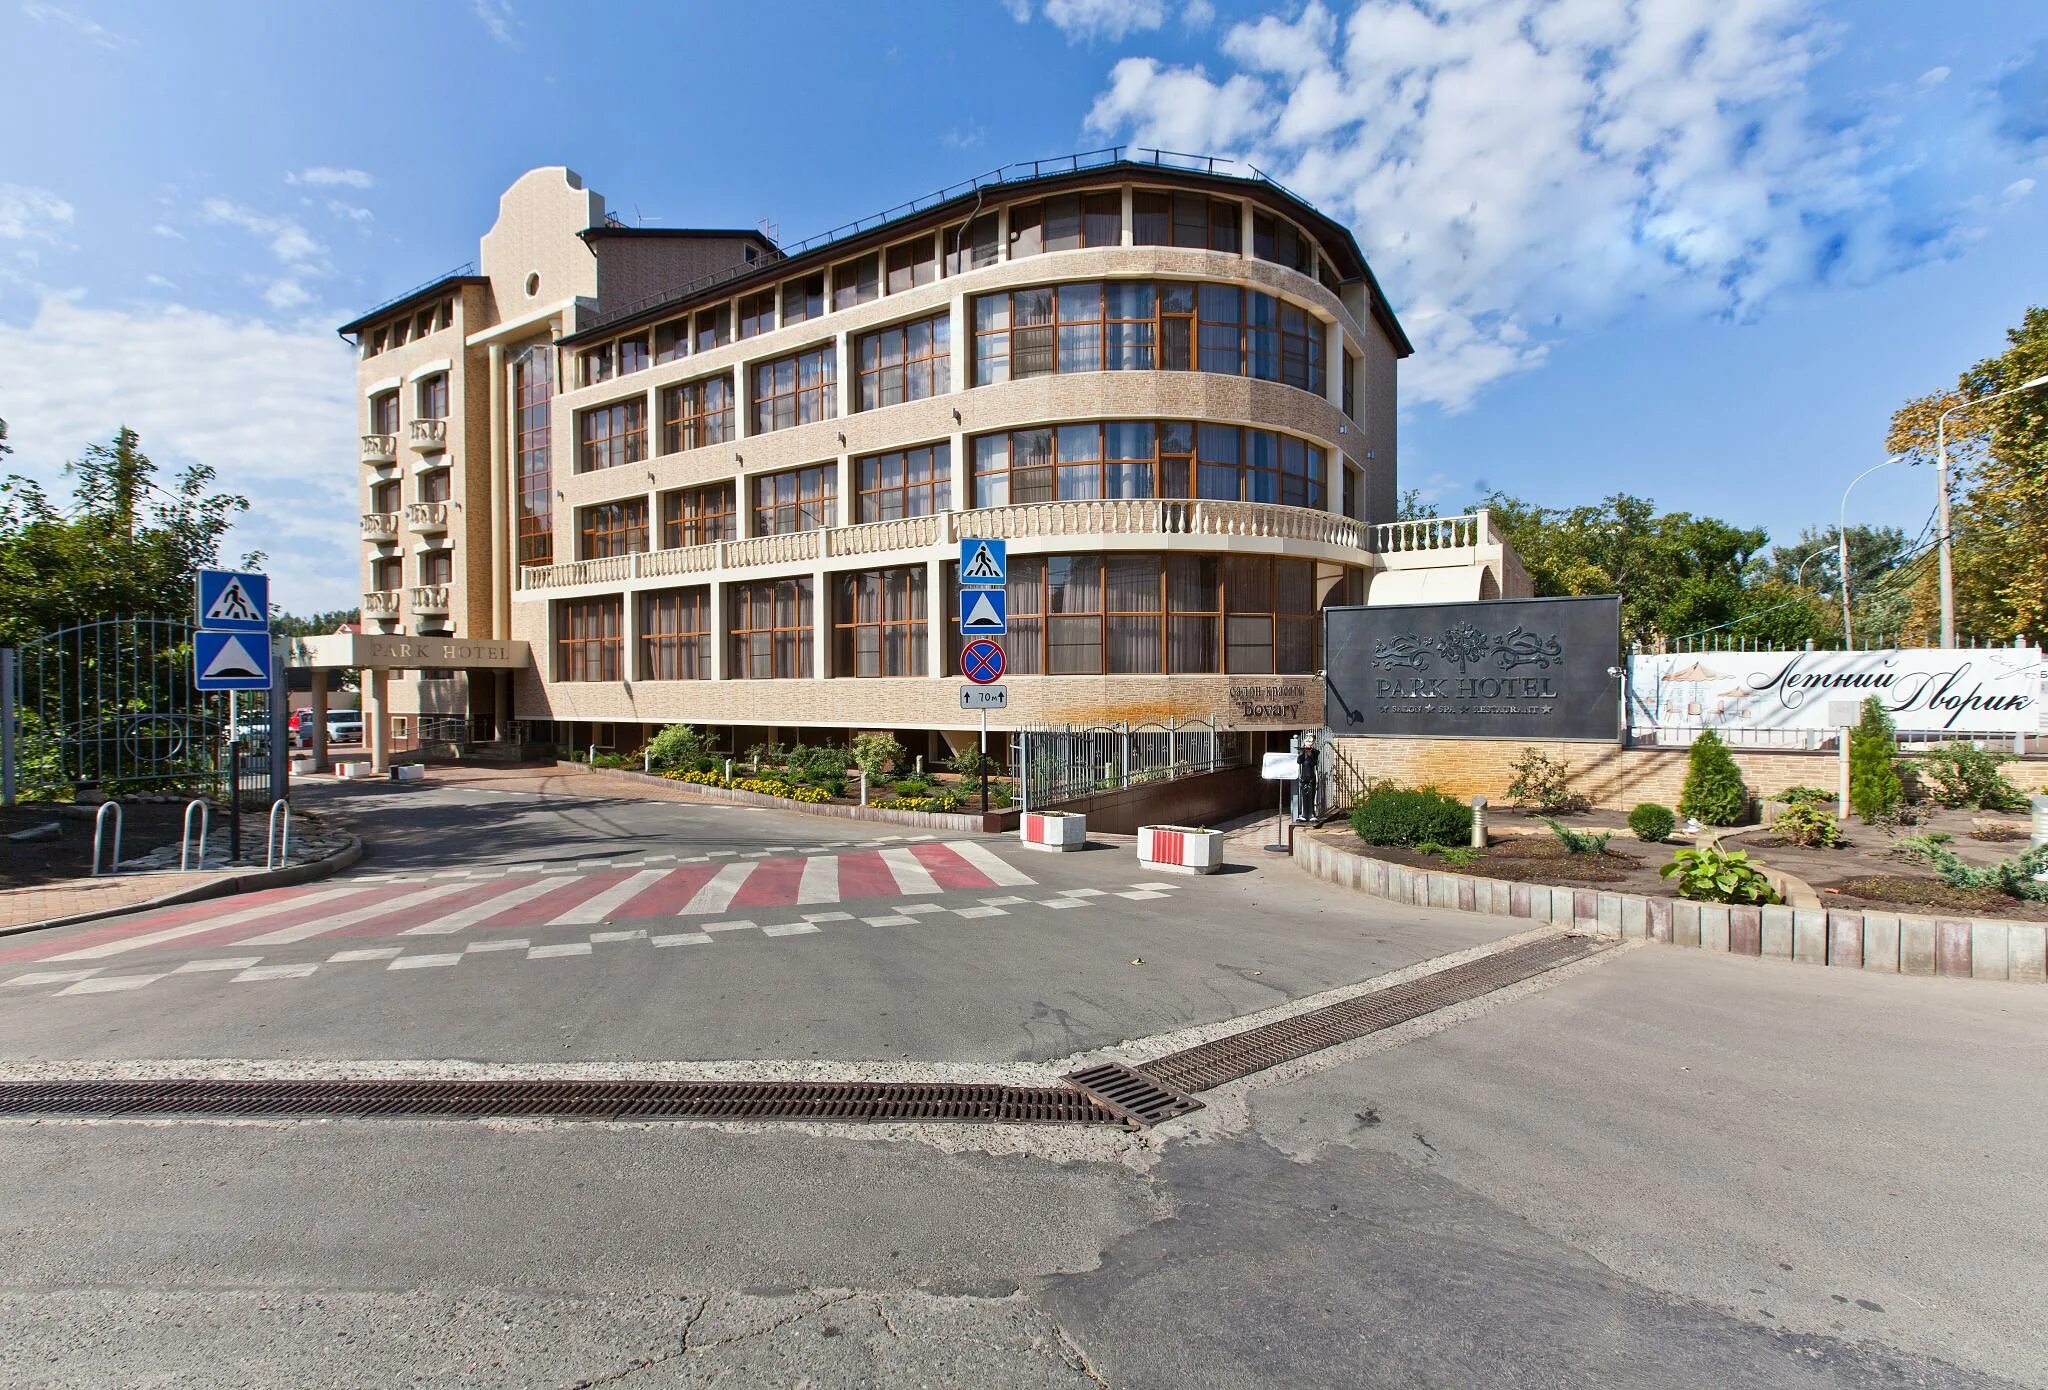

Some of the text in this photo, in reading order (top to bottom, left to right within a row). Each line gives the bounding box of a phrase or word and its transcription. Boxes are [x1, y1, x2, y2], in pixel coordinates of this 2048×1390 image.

[371, 643, 510, 660] PARK HOTEL
[1230, 686, 1261, 698] салон
[1375, 677, 1558, 699] PARK HOTEL
[1747, 653, 2034, 729] Летний Дворик
[1438, 705, 1456, 714] SPA
